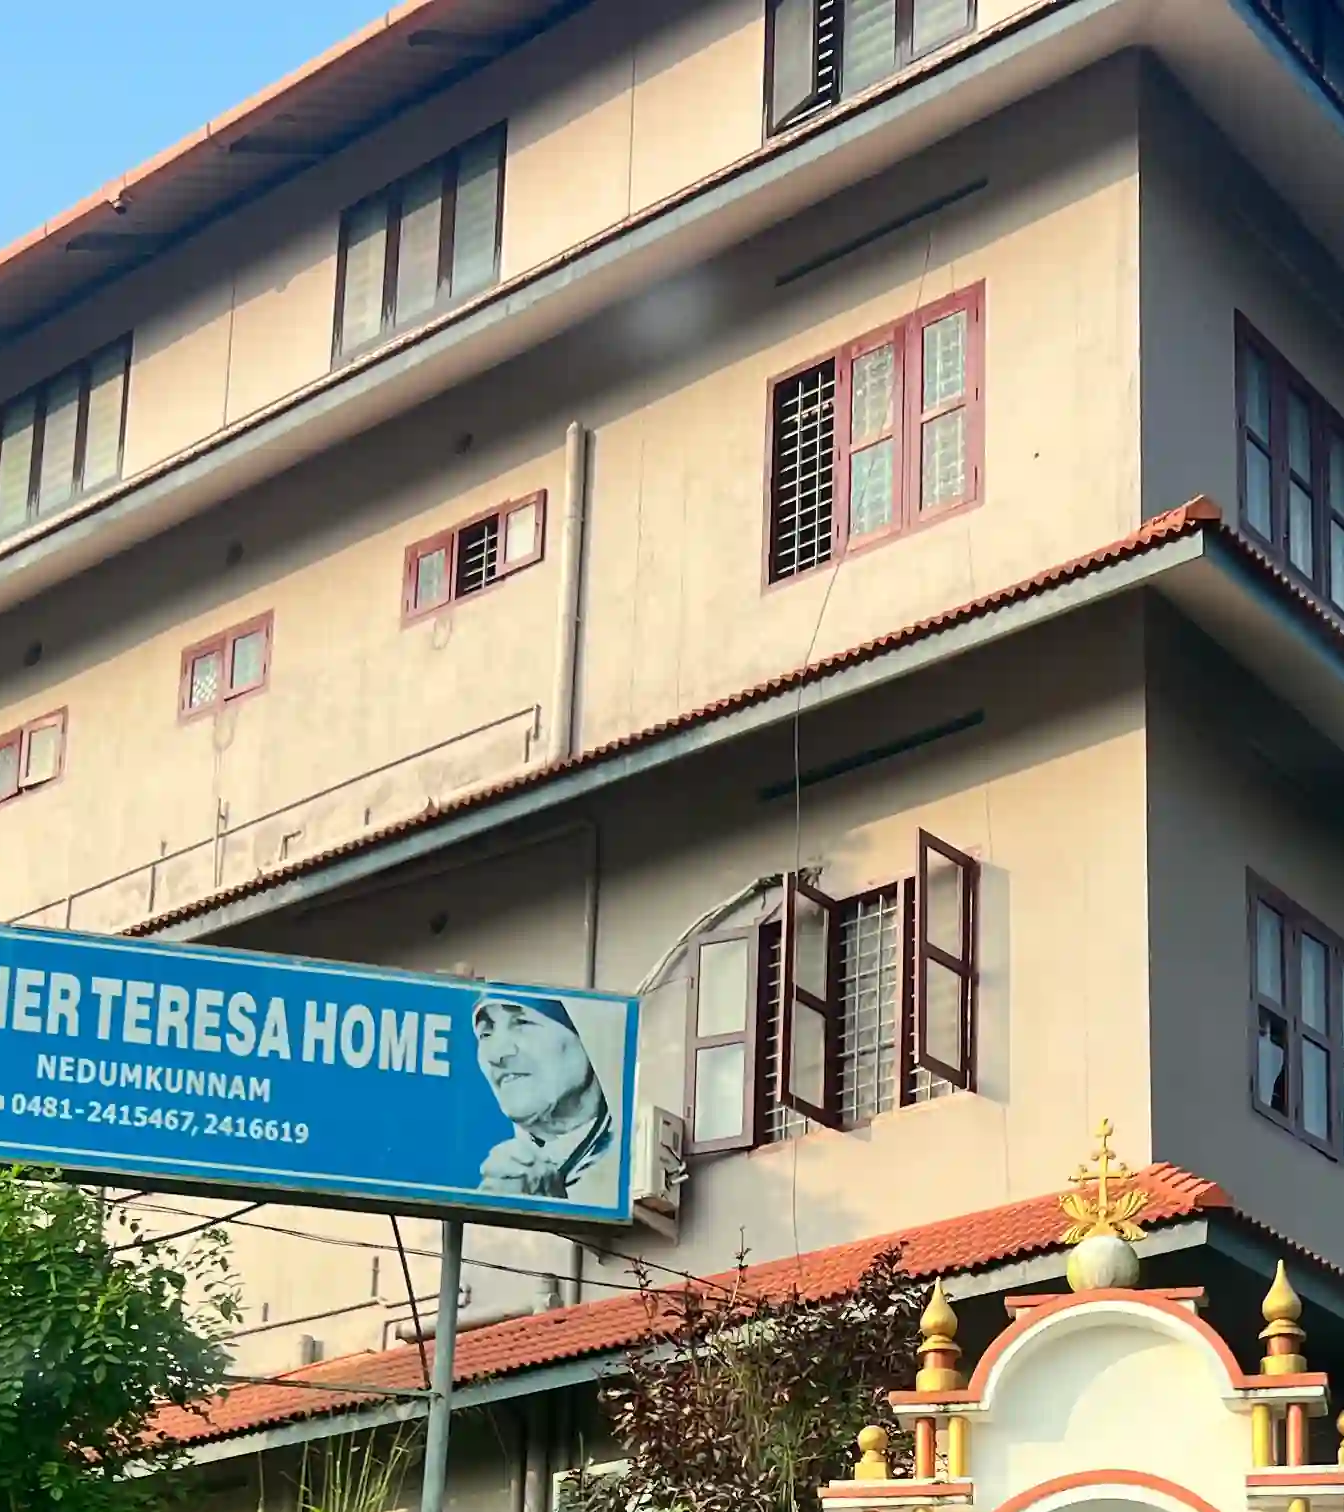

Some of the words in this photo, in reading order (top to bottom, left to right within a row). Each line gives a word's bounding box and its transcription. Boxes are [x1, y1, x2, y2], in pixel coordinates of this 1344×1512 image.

[90, 975, 292, 1061] TERESA
[301, 999, 453, 1078] HOME
[36, 1053, 271, 1103] NEDUMKUNNAM
[10, 1093, 199, 1138] 0481-2415467,
[202, 1112, 310, 1145] 2416619
